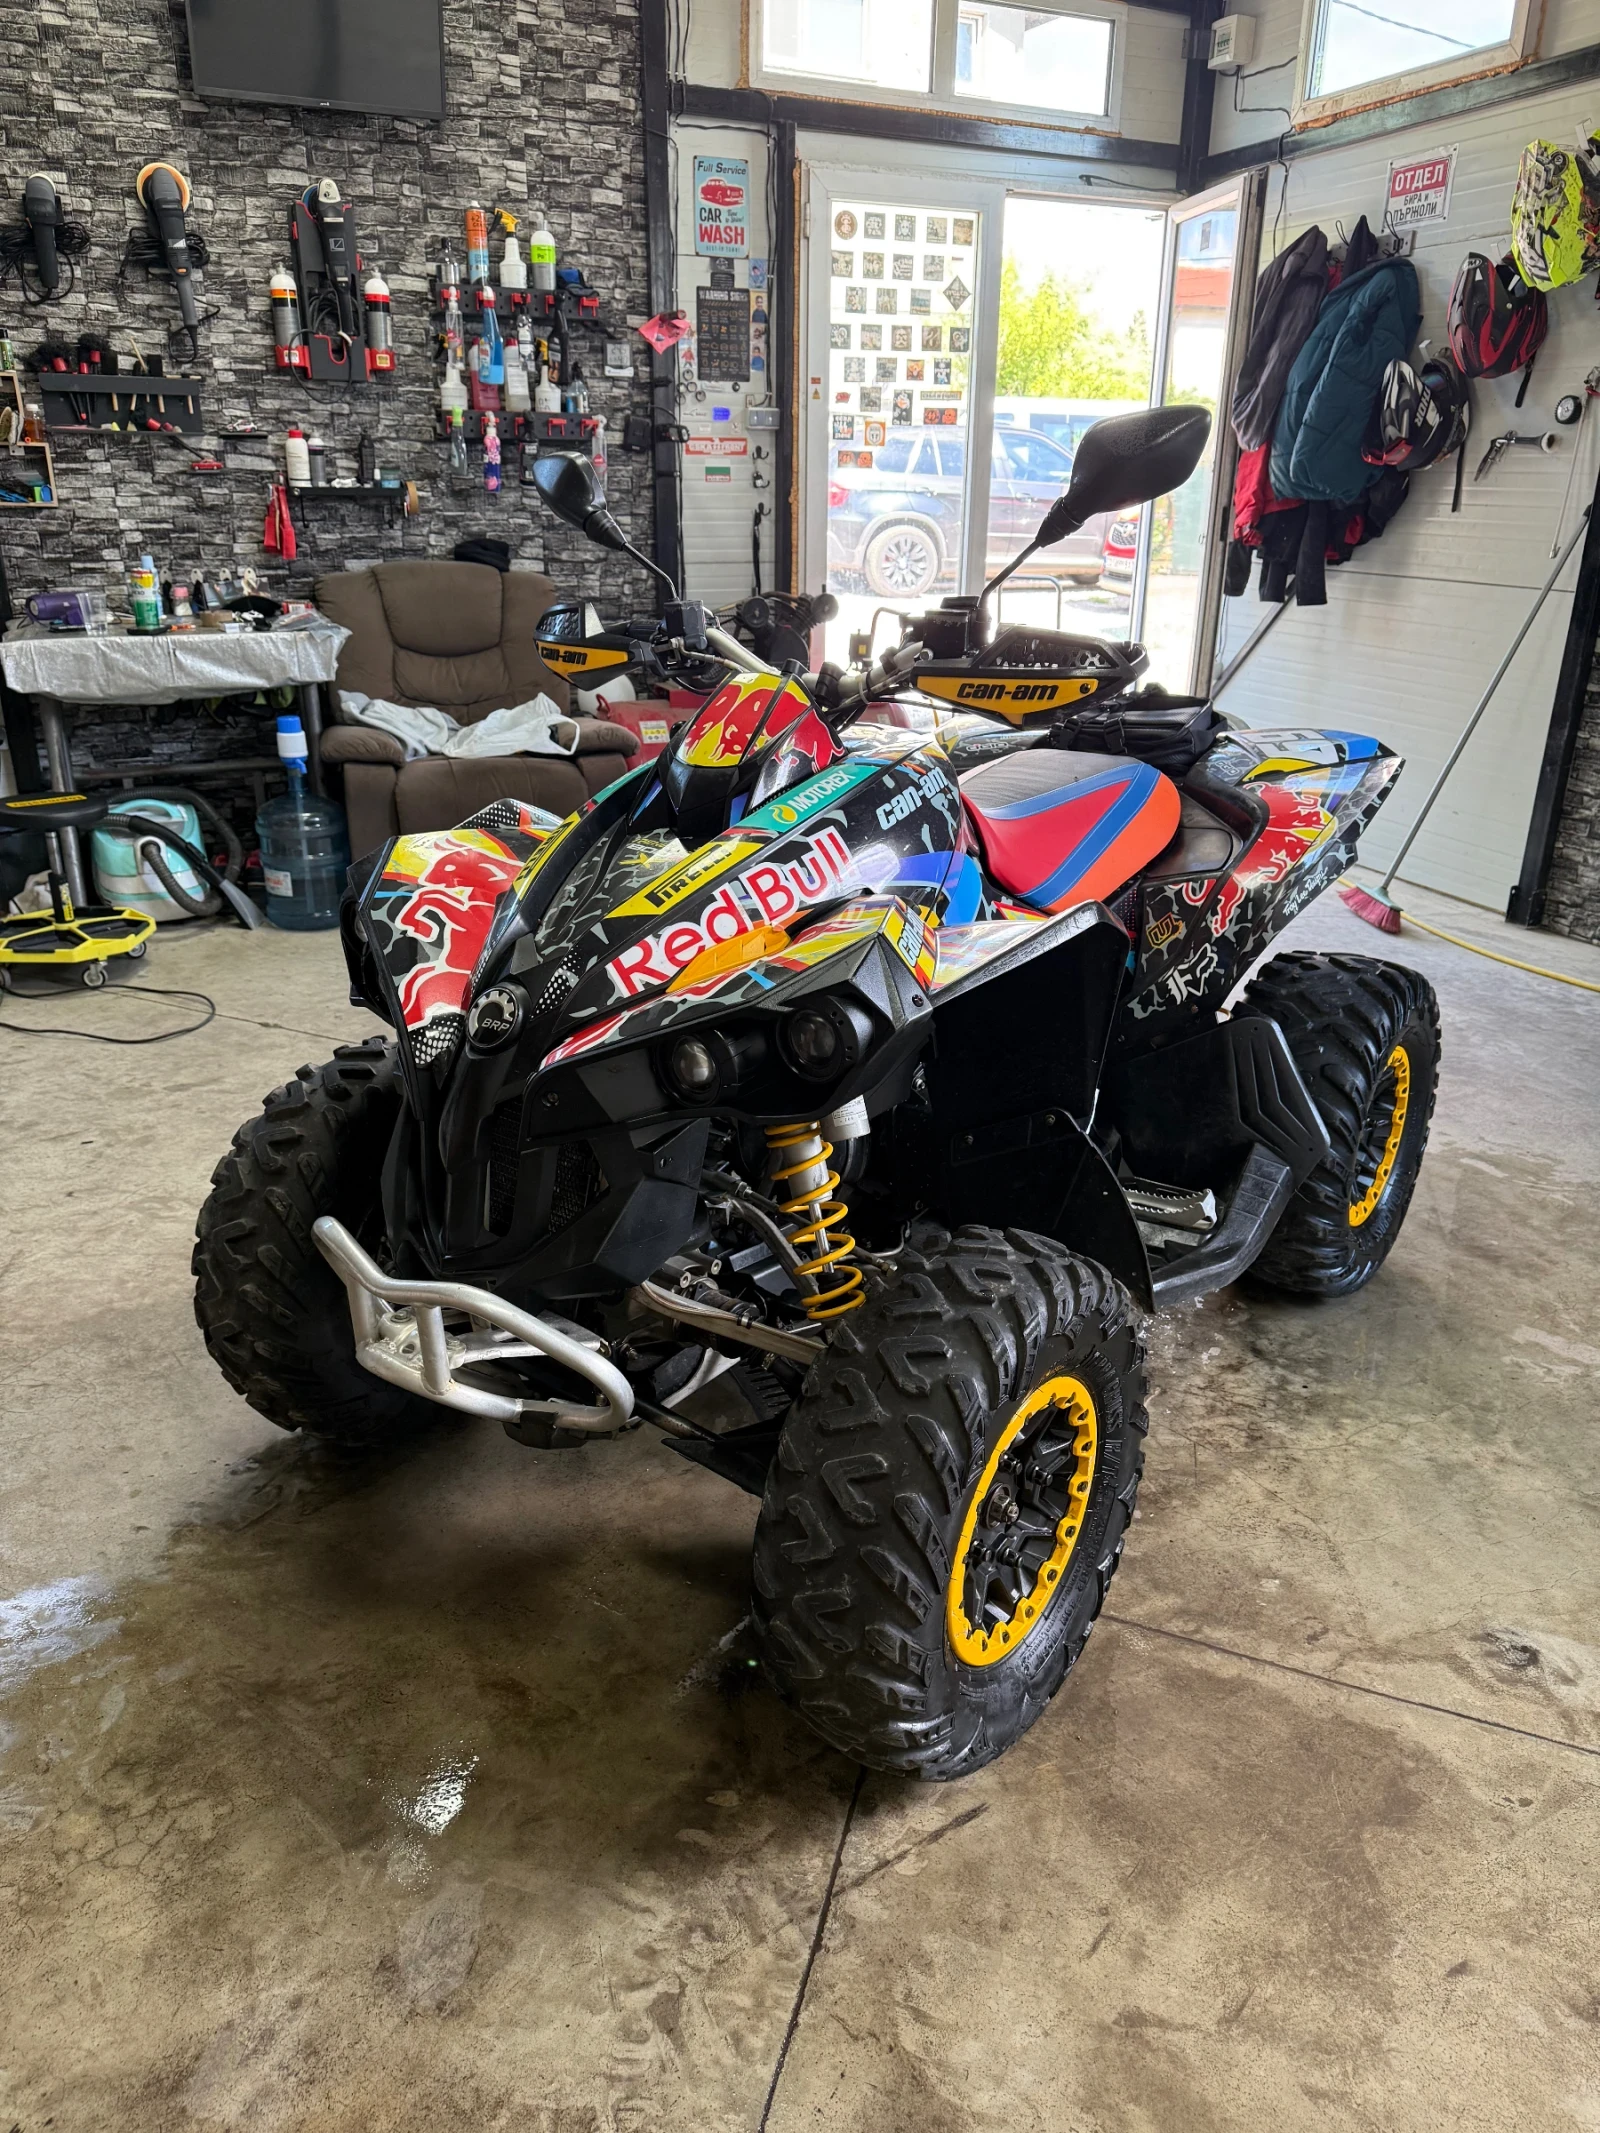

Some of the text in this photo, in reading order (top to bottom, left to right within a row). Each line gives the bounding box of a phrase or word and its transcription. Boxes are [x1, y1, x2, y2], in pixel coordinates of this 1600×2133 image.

[698, 161, 746, 175] Full Service
[1395, 164, 1444, 191] ОТДЕЛ
[1404, 193, 1422, 206] БИРА
[700, 207, 722, 223] CAR
[1393, 202, 1437, 222] ПЪРЖОЛИ
[699, 223, 744, 245] WASH
[1414, 385, 1431, 427] THOR
[541, 647, 588, 665] can-am
[957, 683, 1059, 700] can-am
[788, 771, 856, 812] MOTOREX
[875, 766, 949, 831] can-am
[644, 843, 732, 908] PIRELLI
[610, 830, 852, 997] Red Bull
[897, 906, 925, 968] can-am
[481, 1018, 511, 1031] BRP
